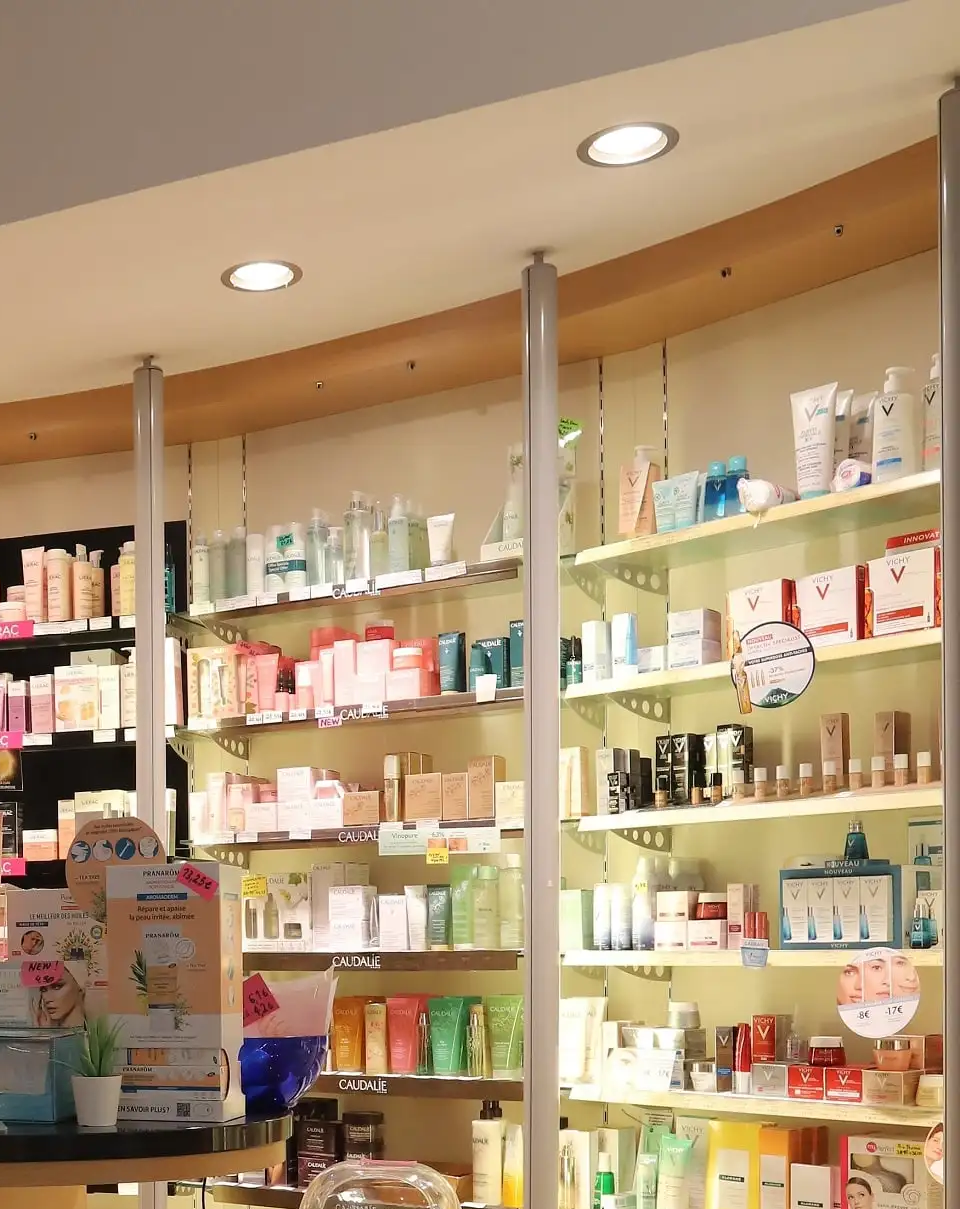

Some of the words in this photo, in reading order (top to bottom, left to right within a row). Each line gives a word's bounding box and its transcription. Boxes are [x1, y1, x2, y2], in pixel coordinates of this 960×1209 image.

[886, 556, 911, 566] VICHY
[812, 575, 833, 584] VICHY
[764, 693, 789, 703] VICHY
[320, 717, 341, 728] NEW
[825, 860, 860, 868] NOUVEAU
[137, 905, 160, 913] Répare
[166, 905, 187, 914] apaise
[129, 913, 135, 921] la
[136, 914, 151, 922] peau
[28, 962, 52, 972] NEW
[856, 1010, 870, 1020] -8€
[884, 1005, 904, 1016] -17€
[681, 1124, 705, 1133] VICHY
